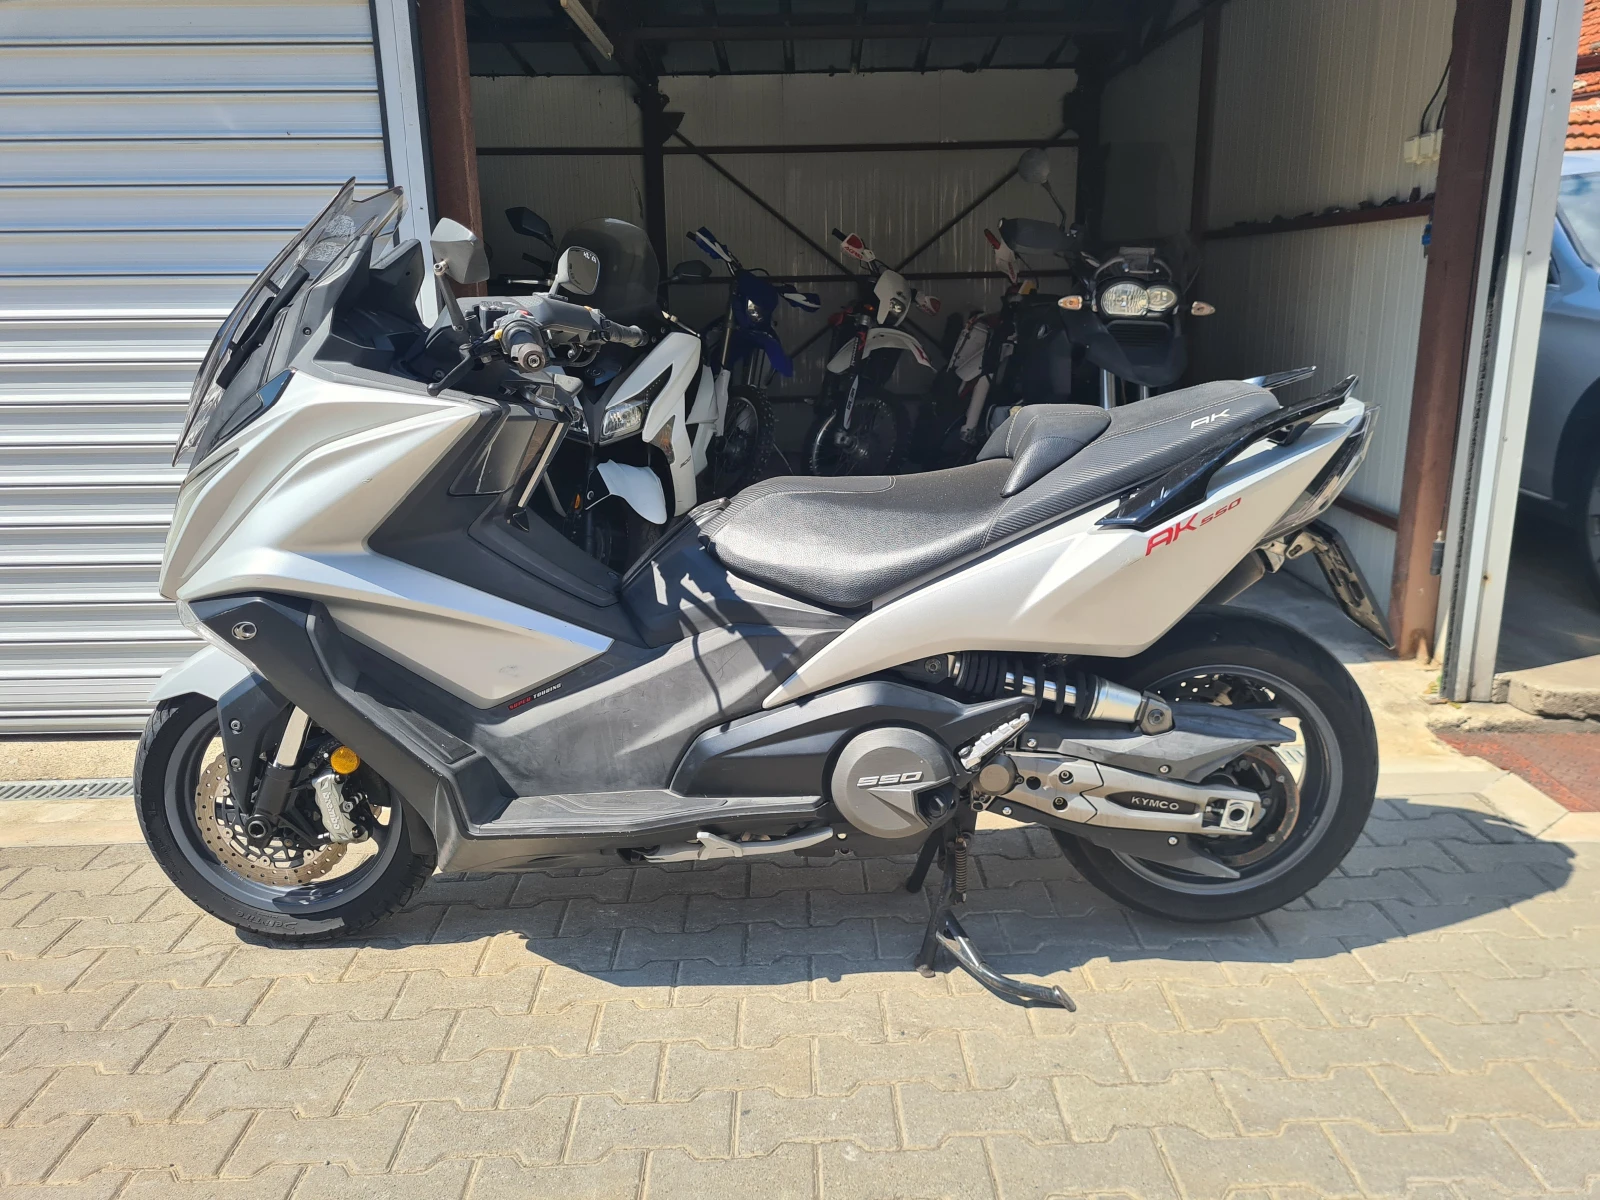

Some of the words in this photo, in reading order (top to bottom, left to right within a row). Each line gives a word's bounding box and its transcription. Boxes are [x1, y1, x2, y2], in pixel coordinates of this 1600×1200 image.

[1190, 407, 1232, 431] AK
[1144, 511, 1198, 558] AK
[1199, 496, 1242, 528] 550
[532, 683, 562, 699] TOURING
[856, 770, 923, 788] 550
[322, 789, 342, 831] brembo
[1131, 796, 1180, 811] KYMCO
